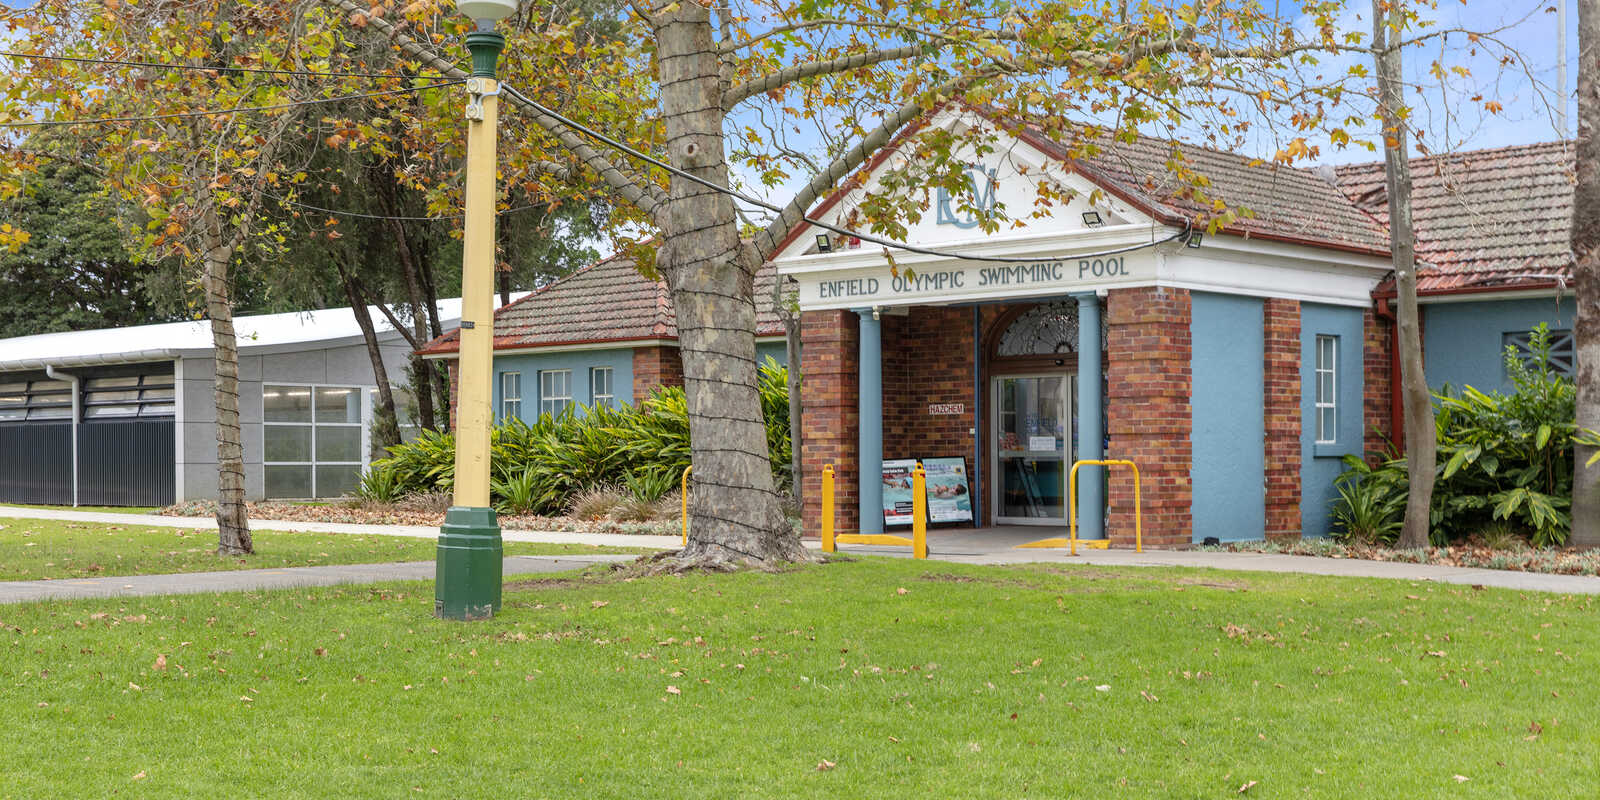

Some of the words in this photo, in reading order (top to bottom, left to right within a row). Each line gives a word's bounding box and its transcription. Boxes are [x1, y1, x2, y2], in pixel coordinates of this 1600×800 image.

[819, 278, 879, 298] ENFIELD
[891, 271, 965, 292] OLYMPIC
[978, 262, 1063, 286] SWIMMING
[1078, 256, 1129, 279] POOL
[929, 403, 964, 414] HAZCHEM
